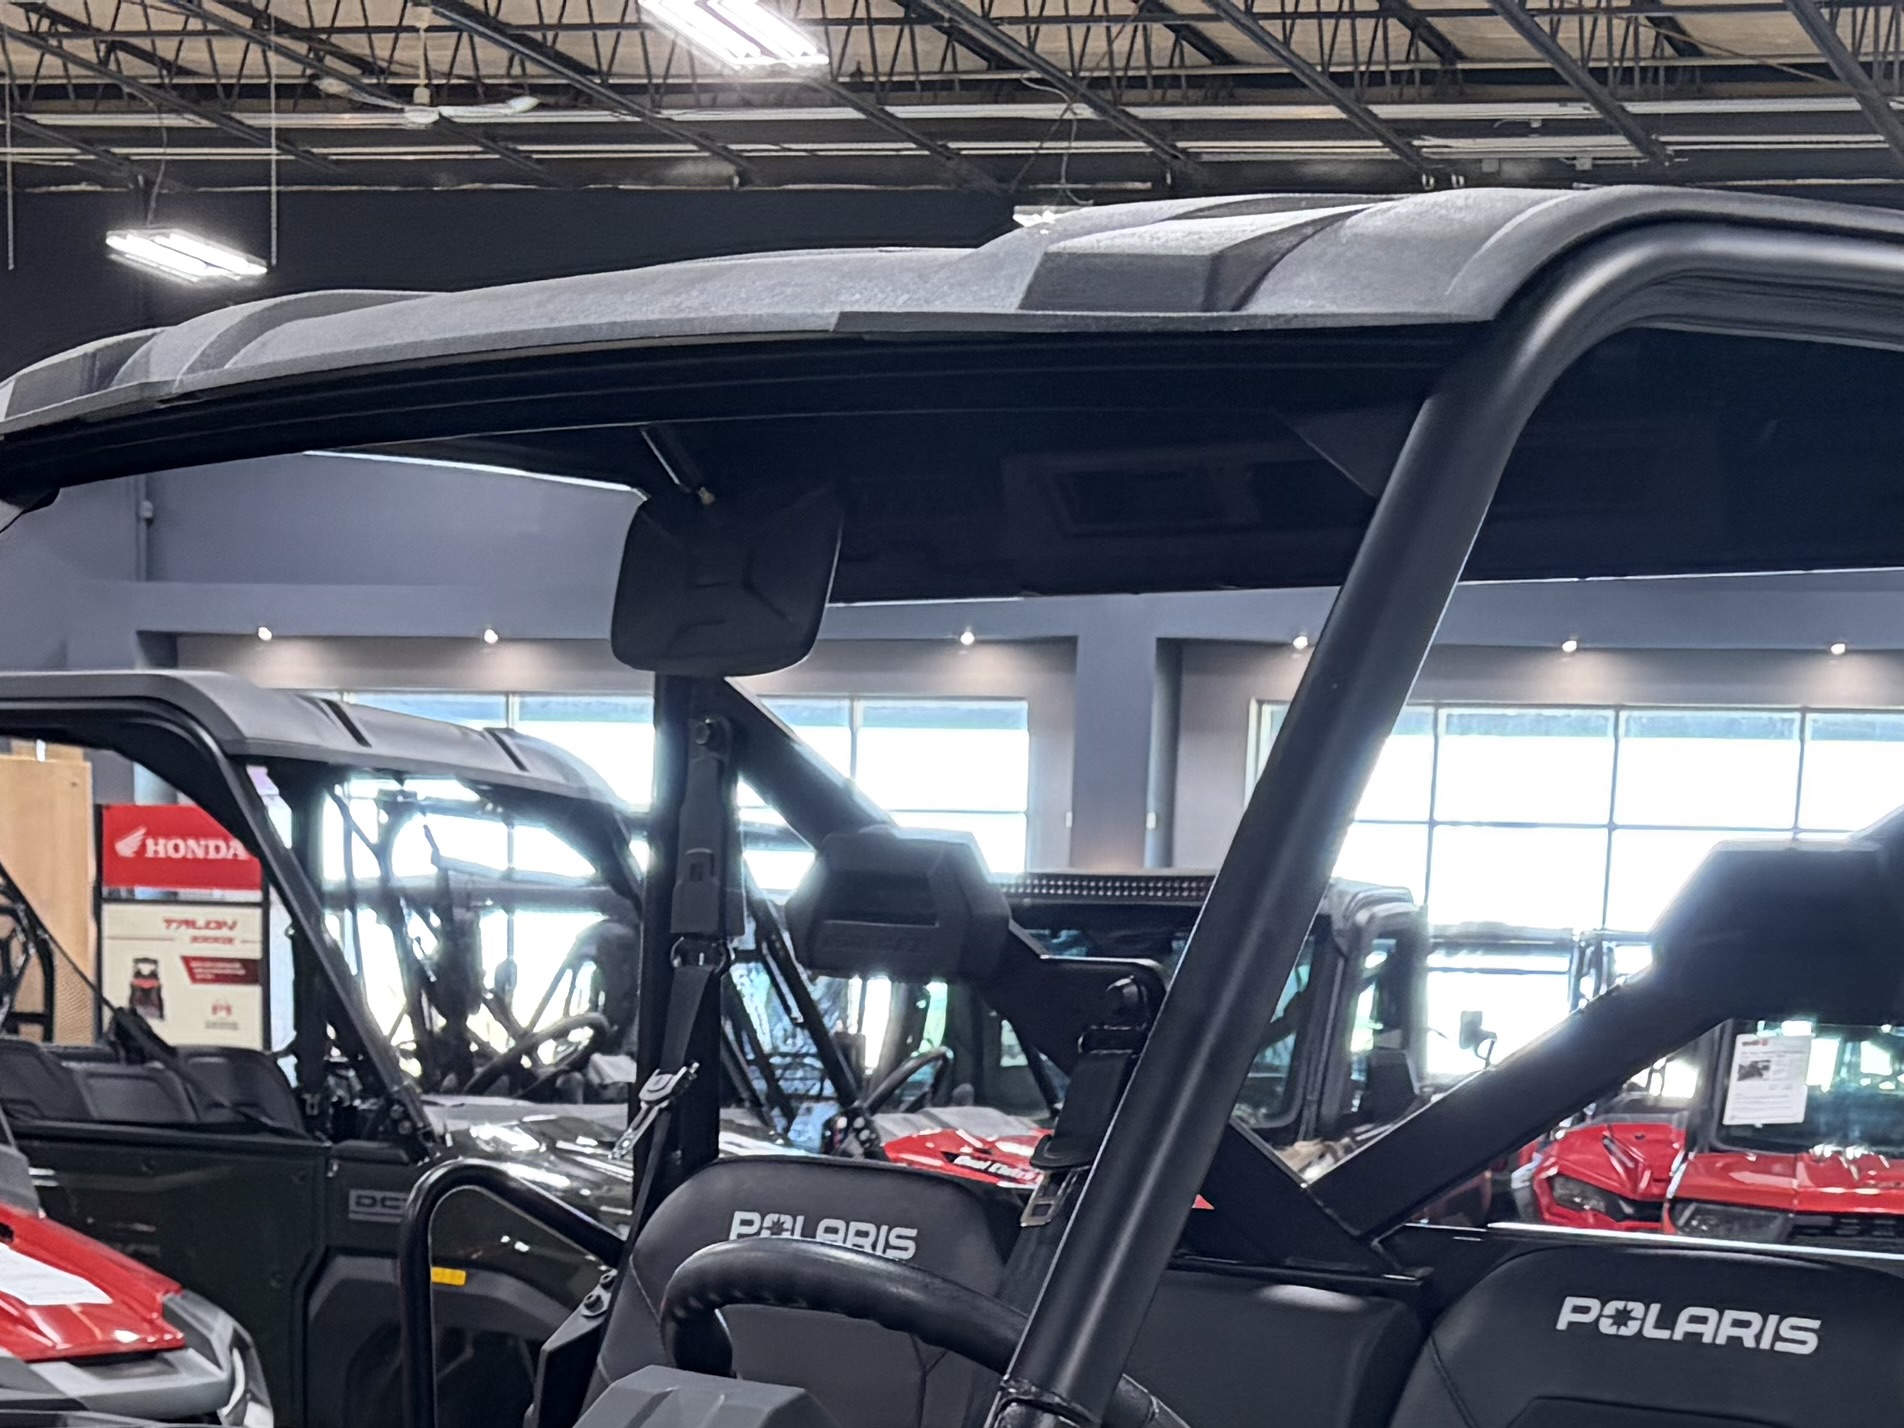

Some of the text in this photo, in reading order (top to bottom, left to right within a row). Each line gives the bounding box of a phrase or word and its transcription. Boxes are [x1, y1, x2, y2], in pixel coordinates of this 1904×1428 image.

[145, 837, 250, 860] HONDA
[163, 919, 238, 931] TALON
[729, 1210, 918, 1260] POLARIS
[1555, 1296, 1822, 1356] POLARIS
